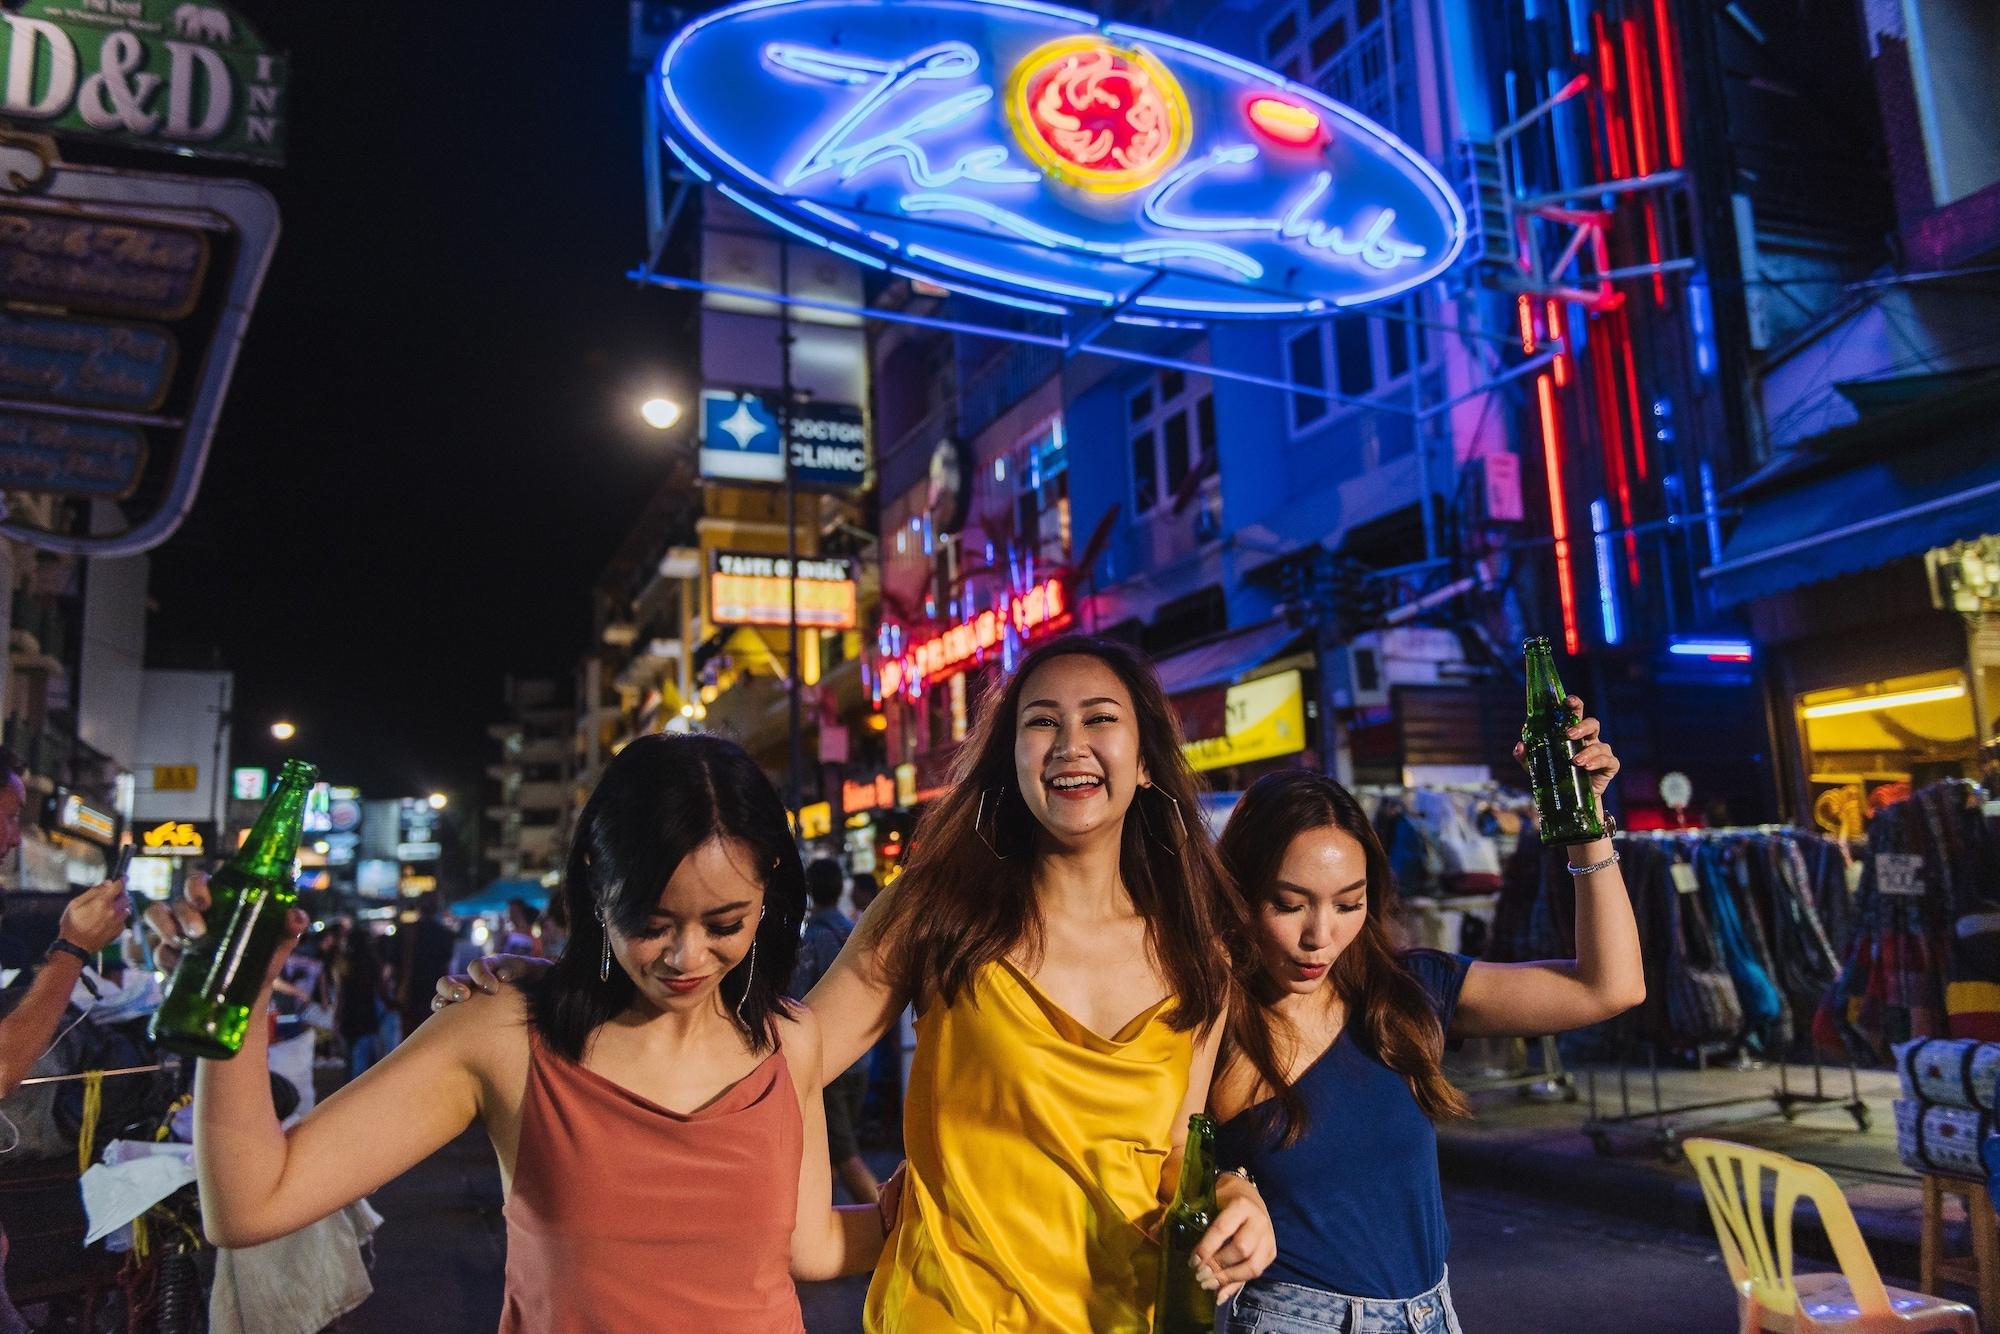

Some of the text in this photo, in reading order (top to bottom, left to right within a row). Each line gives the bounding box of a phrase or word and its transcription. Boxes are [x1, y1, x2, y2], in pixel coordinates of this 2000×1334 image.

[1, 12, 234, 141] D&D
[247, 55, 283, 144] INN
[764, 39, 1427, 270] The Club
[790, 442, 865, 472] CLINIC
